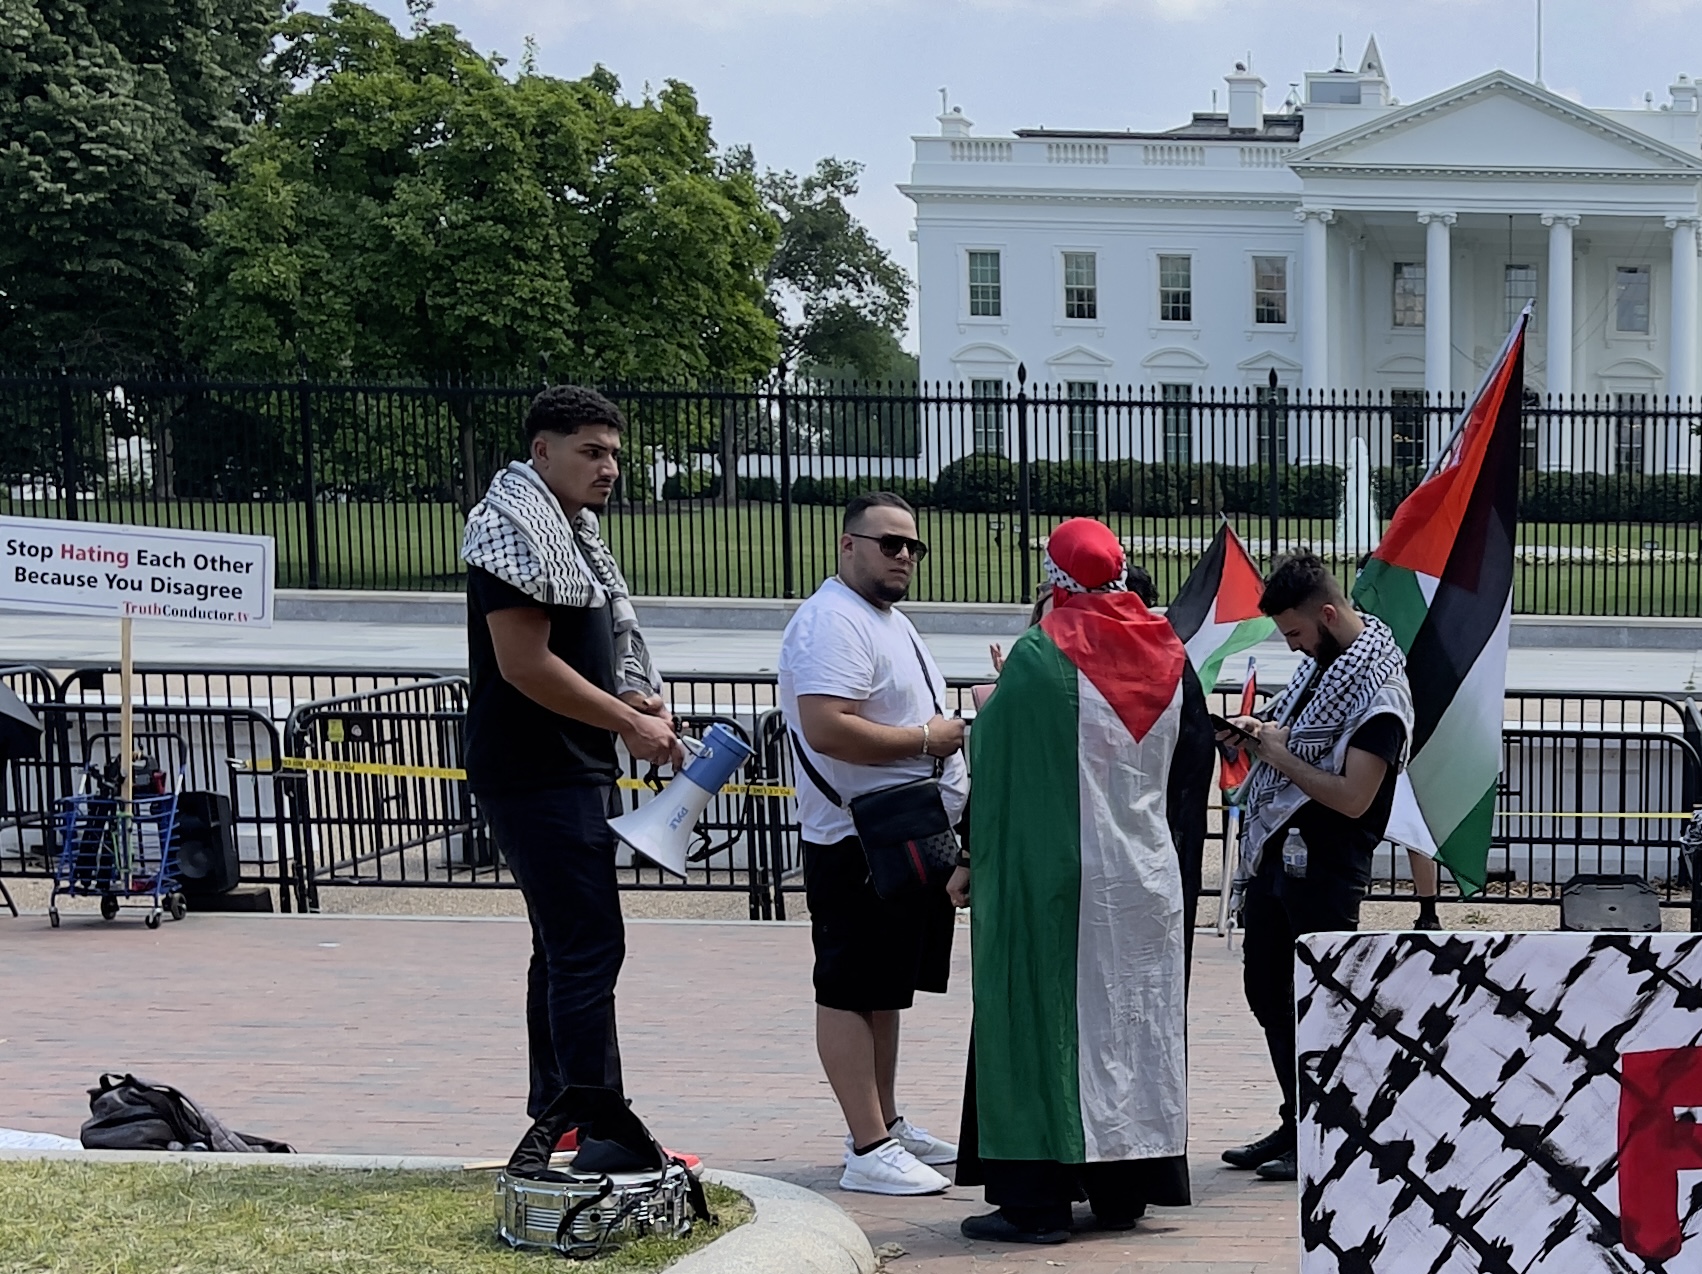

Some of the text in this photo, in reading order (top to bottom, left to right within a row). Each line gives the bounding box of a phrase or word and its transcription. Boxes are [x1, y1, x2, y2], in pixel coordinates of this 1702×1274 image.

[6, 539, 254, 574] Stop Hating Each Other
[14, 566, 243, 601] Because You Disagree
[123, 601, 249, 623] TruthConductor.tv
